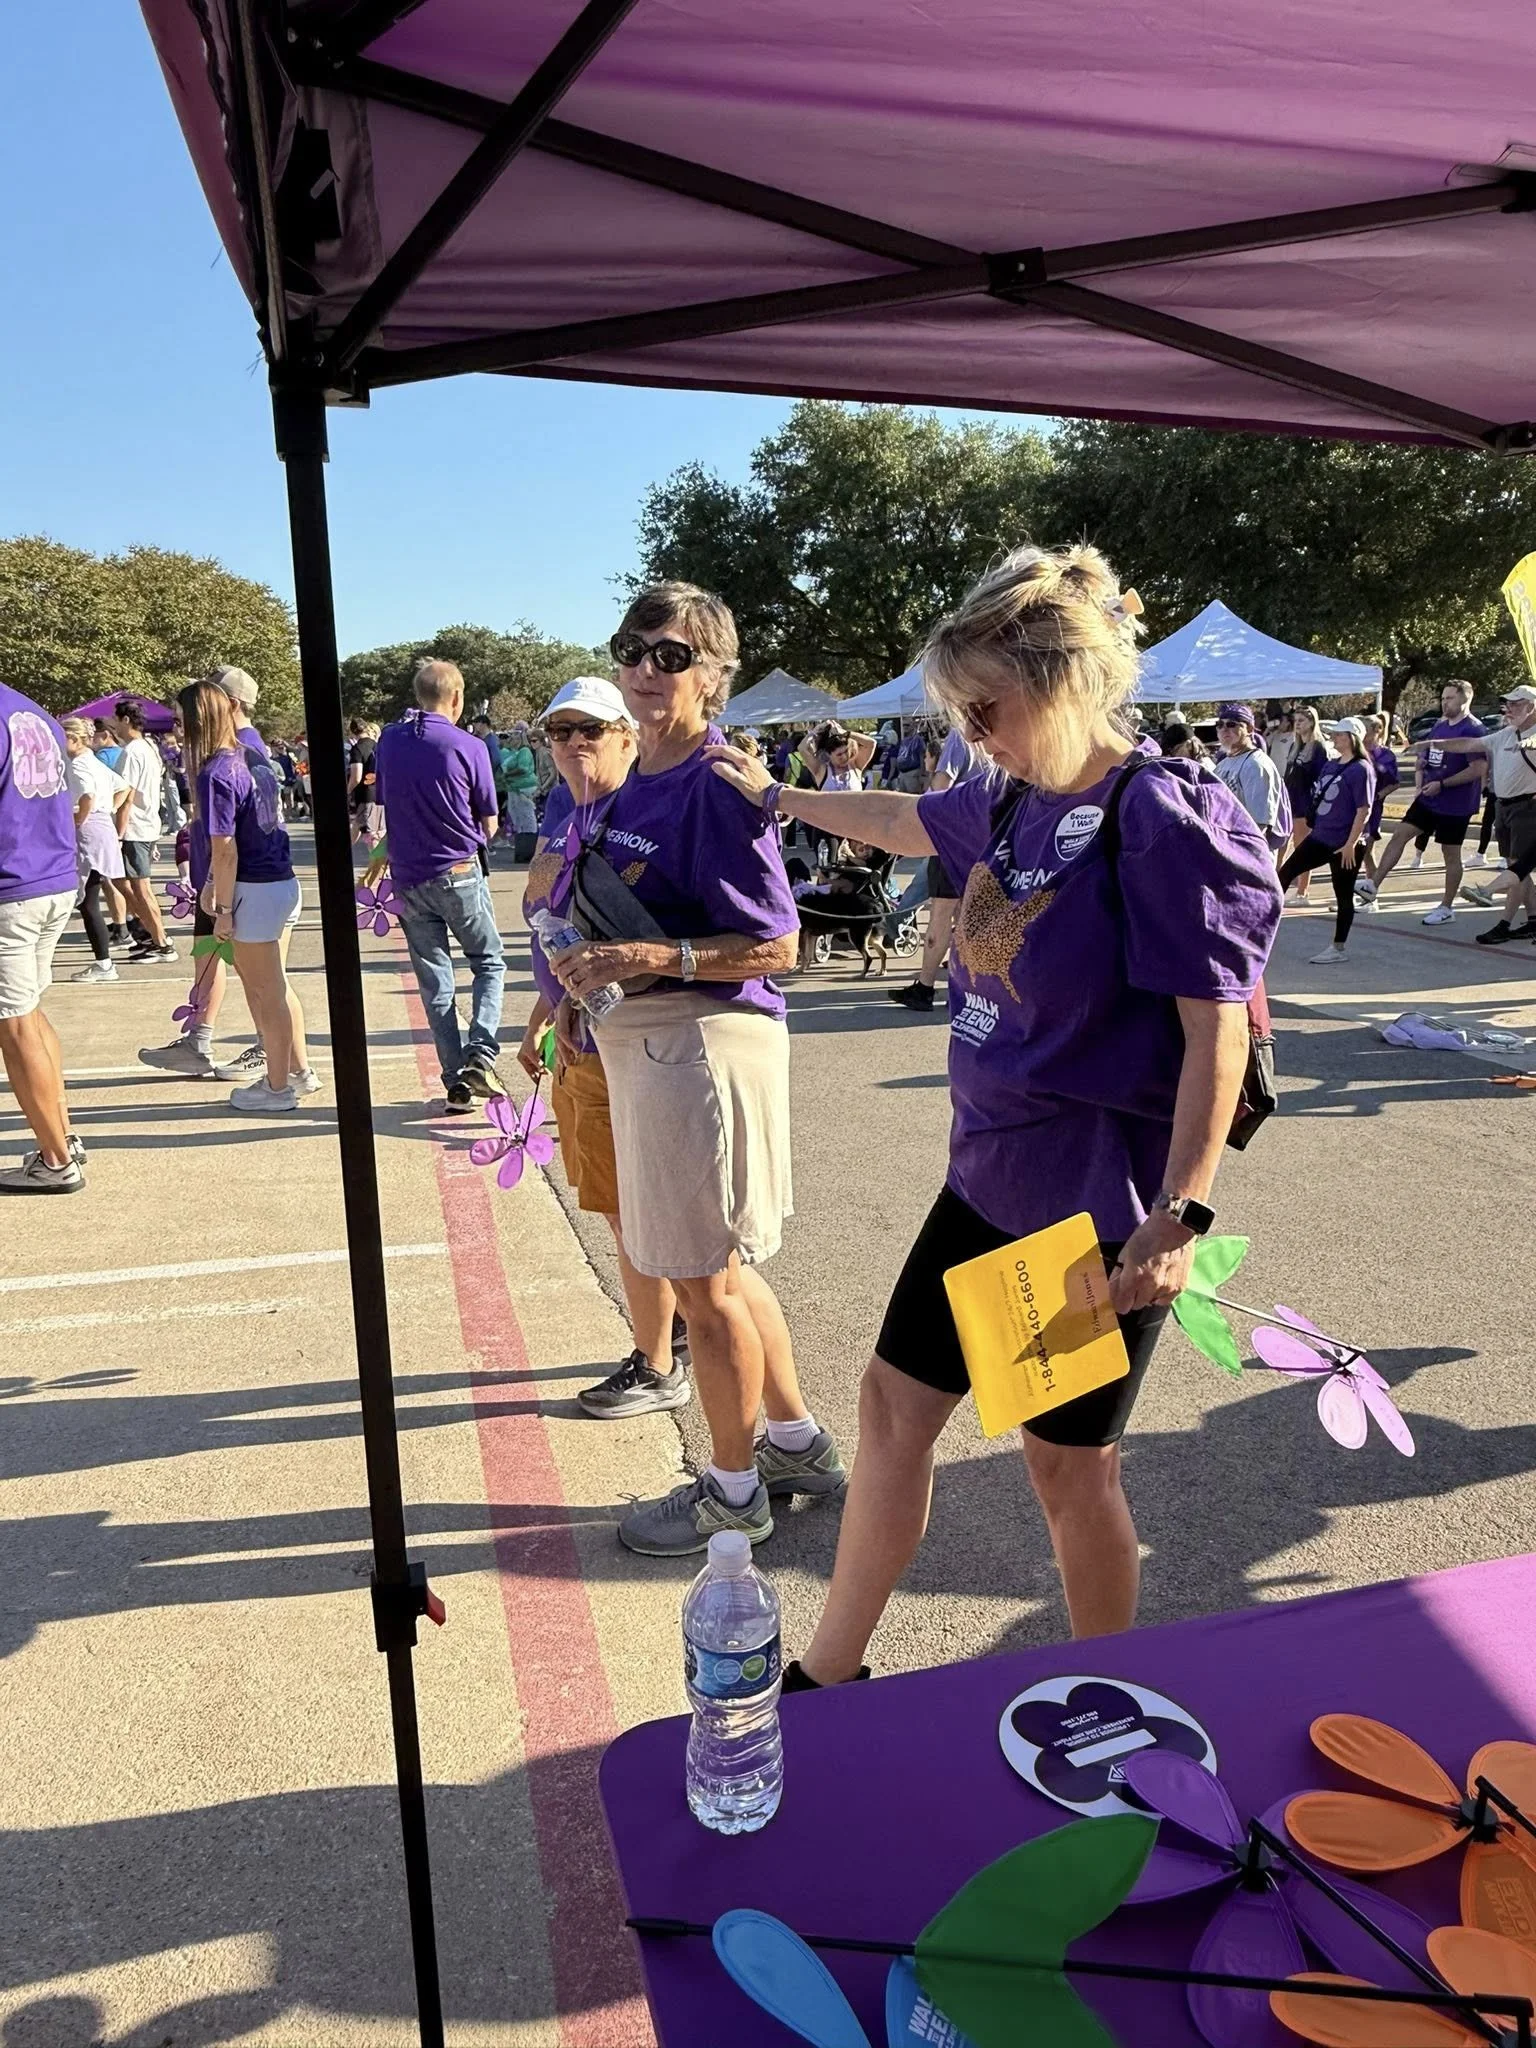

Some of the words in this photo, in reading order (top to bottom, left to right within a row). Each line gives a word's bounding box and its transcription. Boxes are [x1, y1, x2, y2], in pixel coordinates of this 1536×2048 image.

[964, 991, 1000, 1020] WALK
[965, 1010, 996, 1034] END
[1015, 1260, 1056, 1392] 1-844-440-6600
[907, 1995, 933, 2037] WAL
